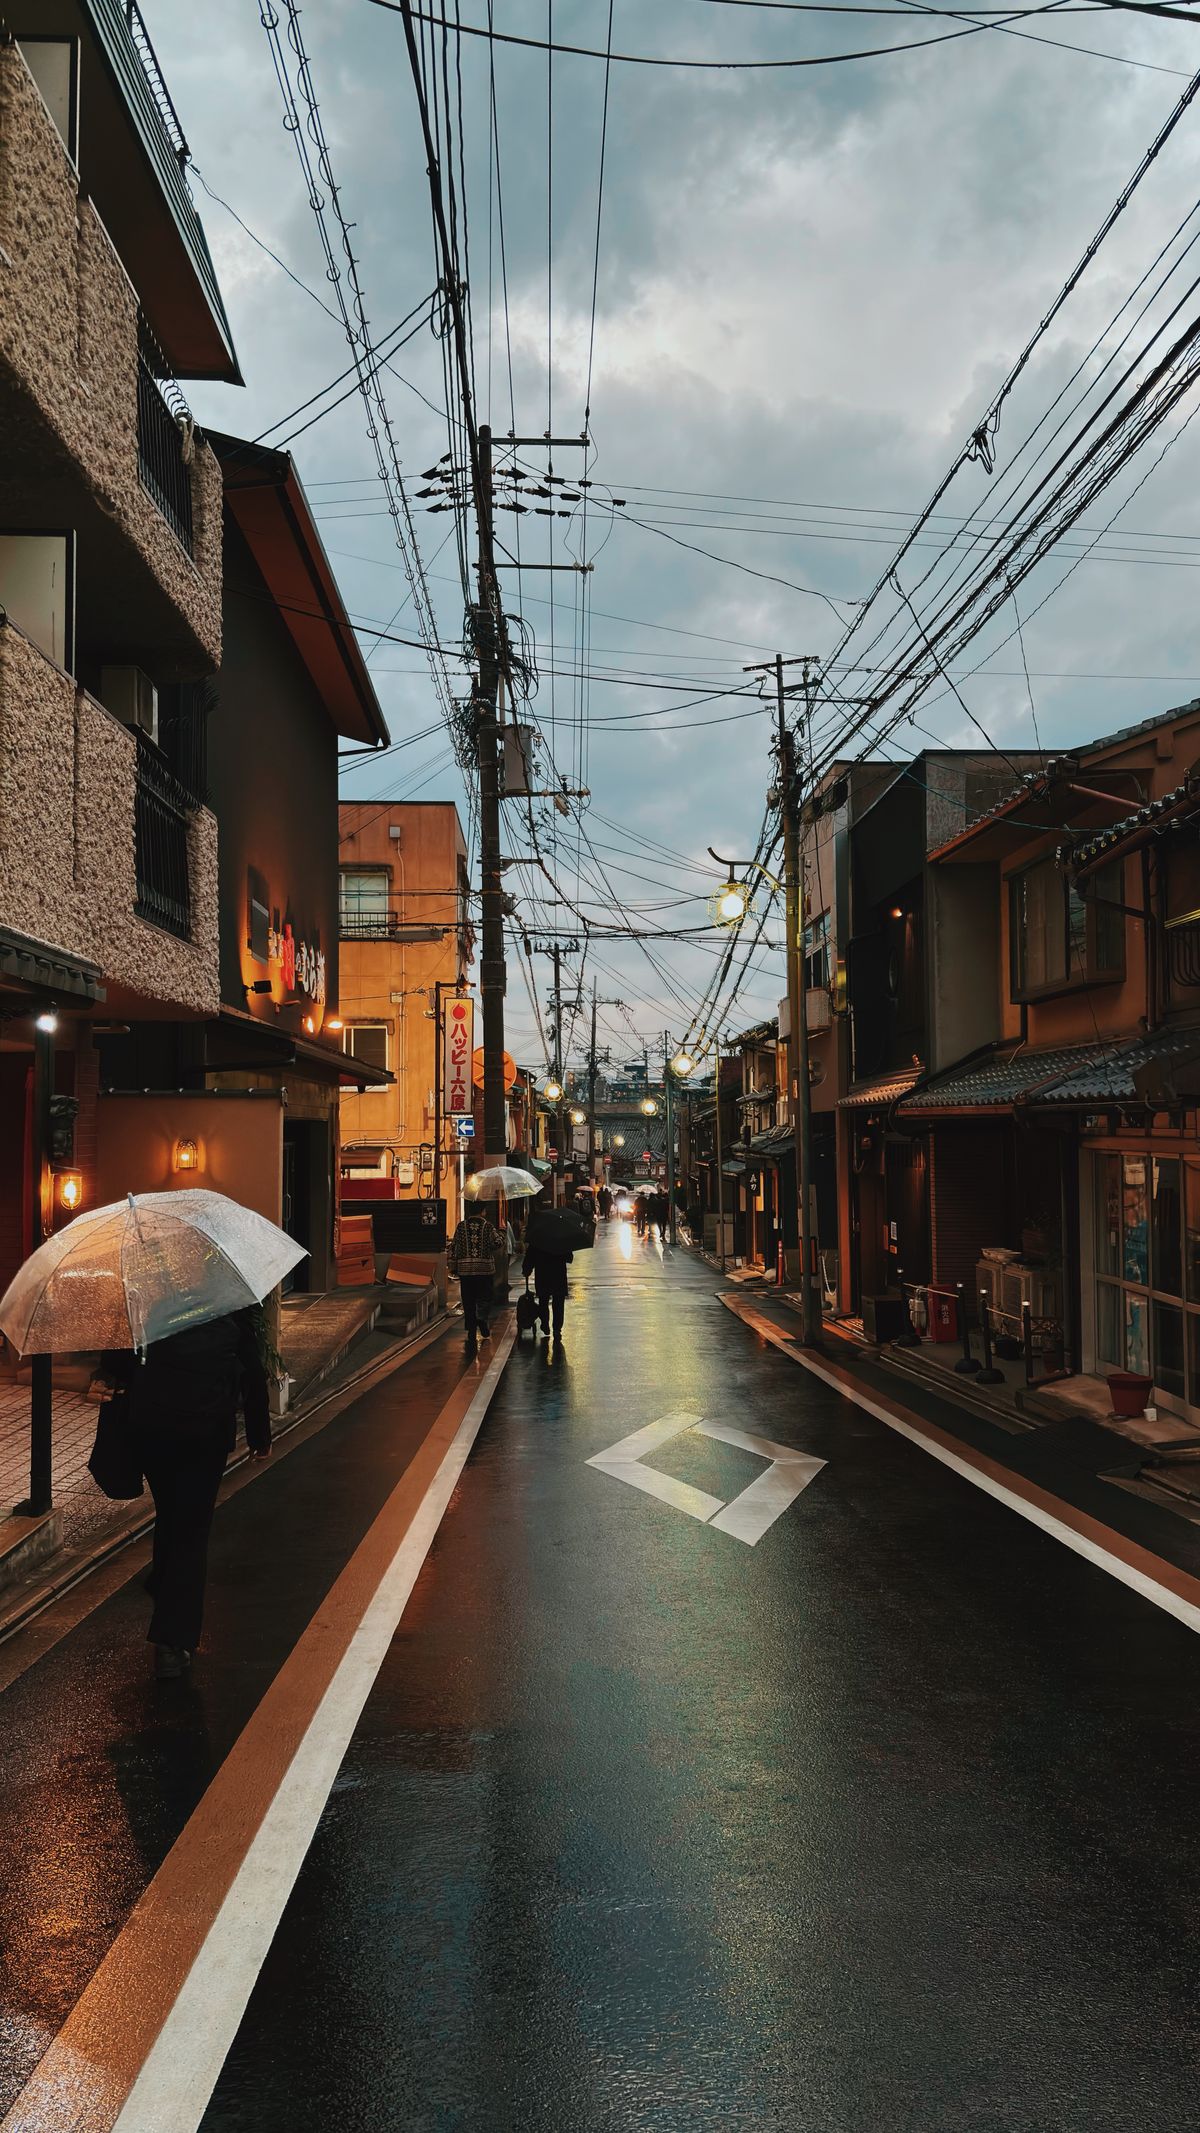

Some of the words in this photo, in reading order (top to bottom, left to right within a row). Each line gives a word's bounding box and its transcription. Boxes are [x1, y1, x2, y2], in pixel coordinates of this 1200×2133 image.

[450, 1023, 467, 1110] ハッピー六原
